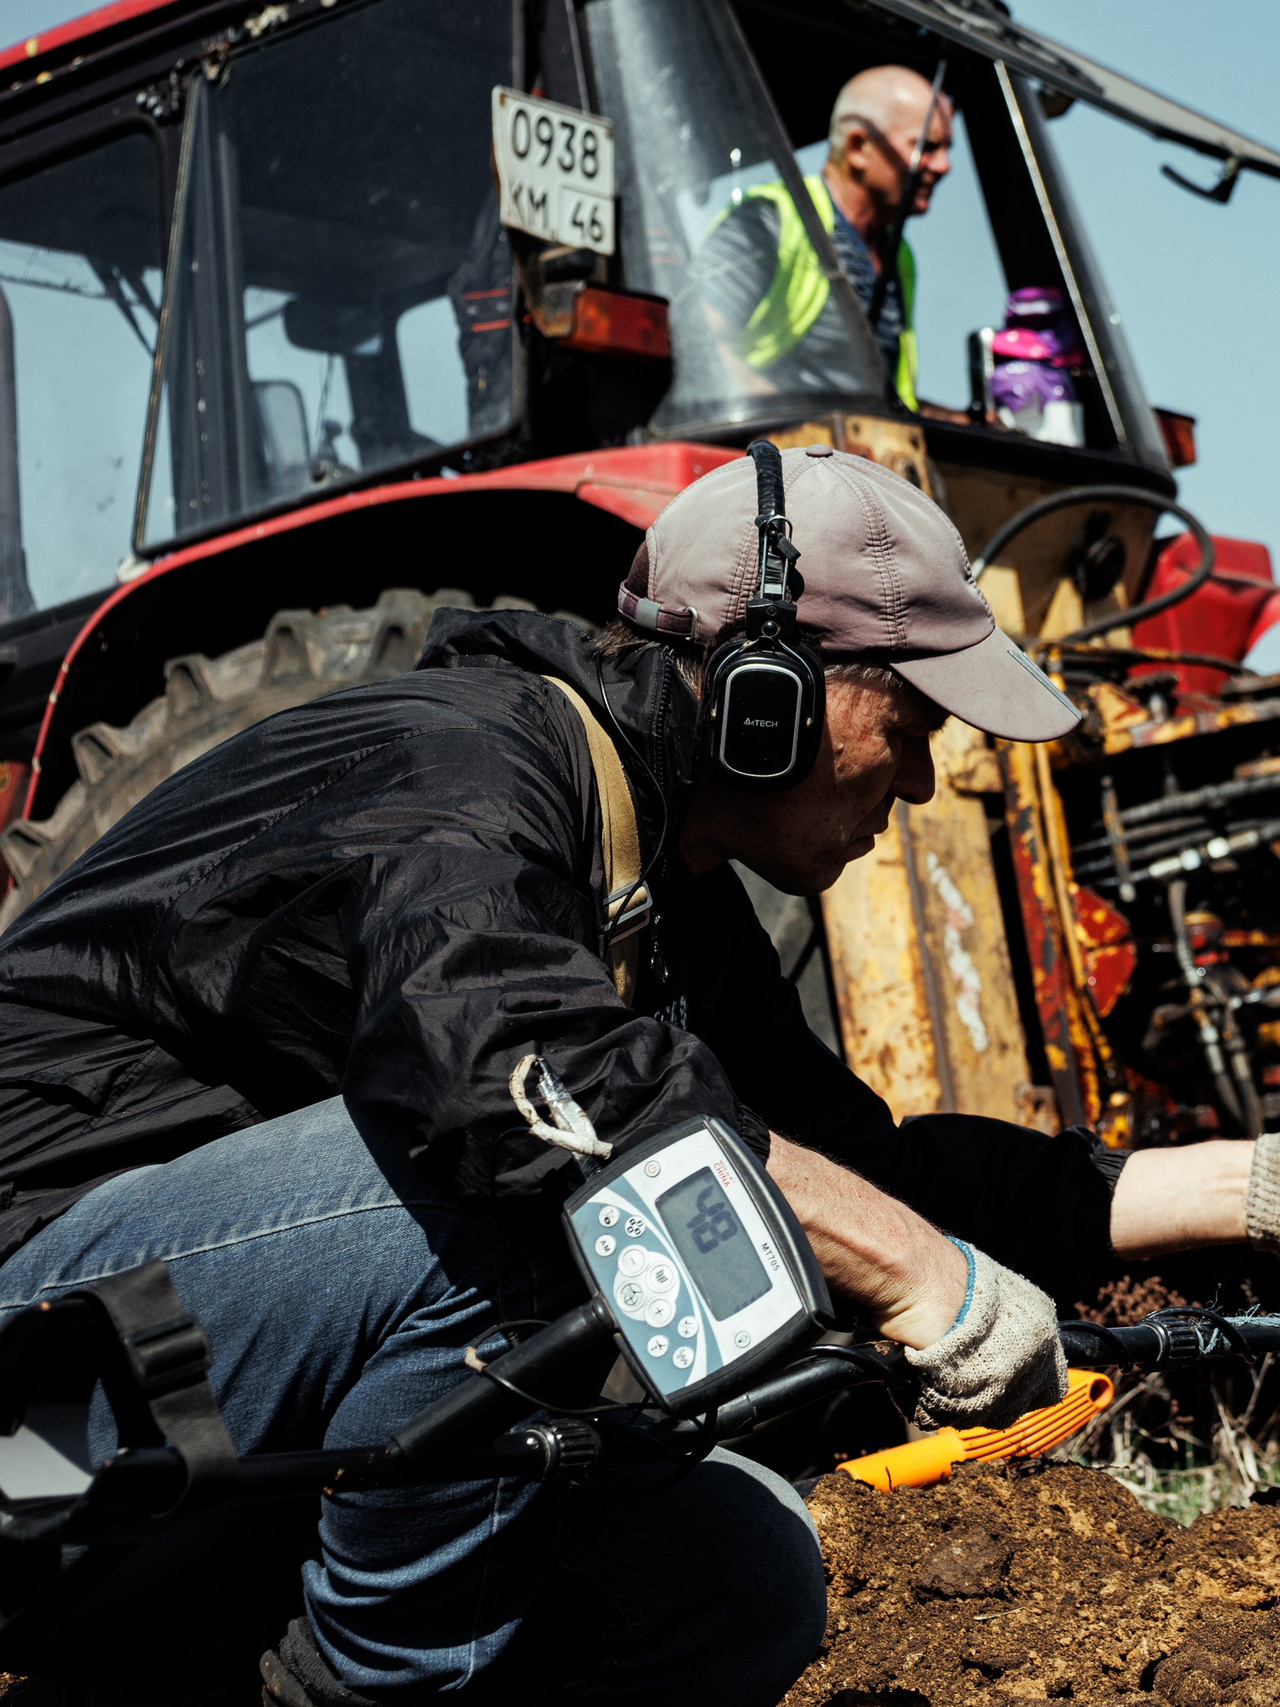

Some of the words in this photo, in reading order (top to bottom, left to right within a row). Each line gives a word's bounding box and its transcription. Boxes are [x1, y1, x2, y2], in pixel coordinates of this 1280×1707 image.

[512, 109, 599, 179] 0938
[571, 200, 605, 243] 46
[714, 1162, 730, 1188] CHINA
[600, 1240, 611, 1253] AM
[761, 1242, 780, 1272] MT705
